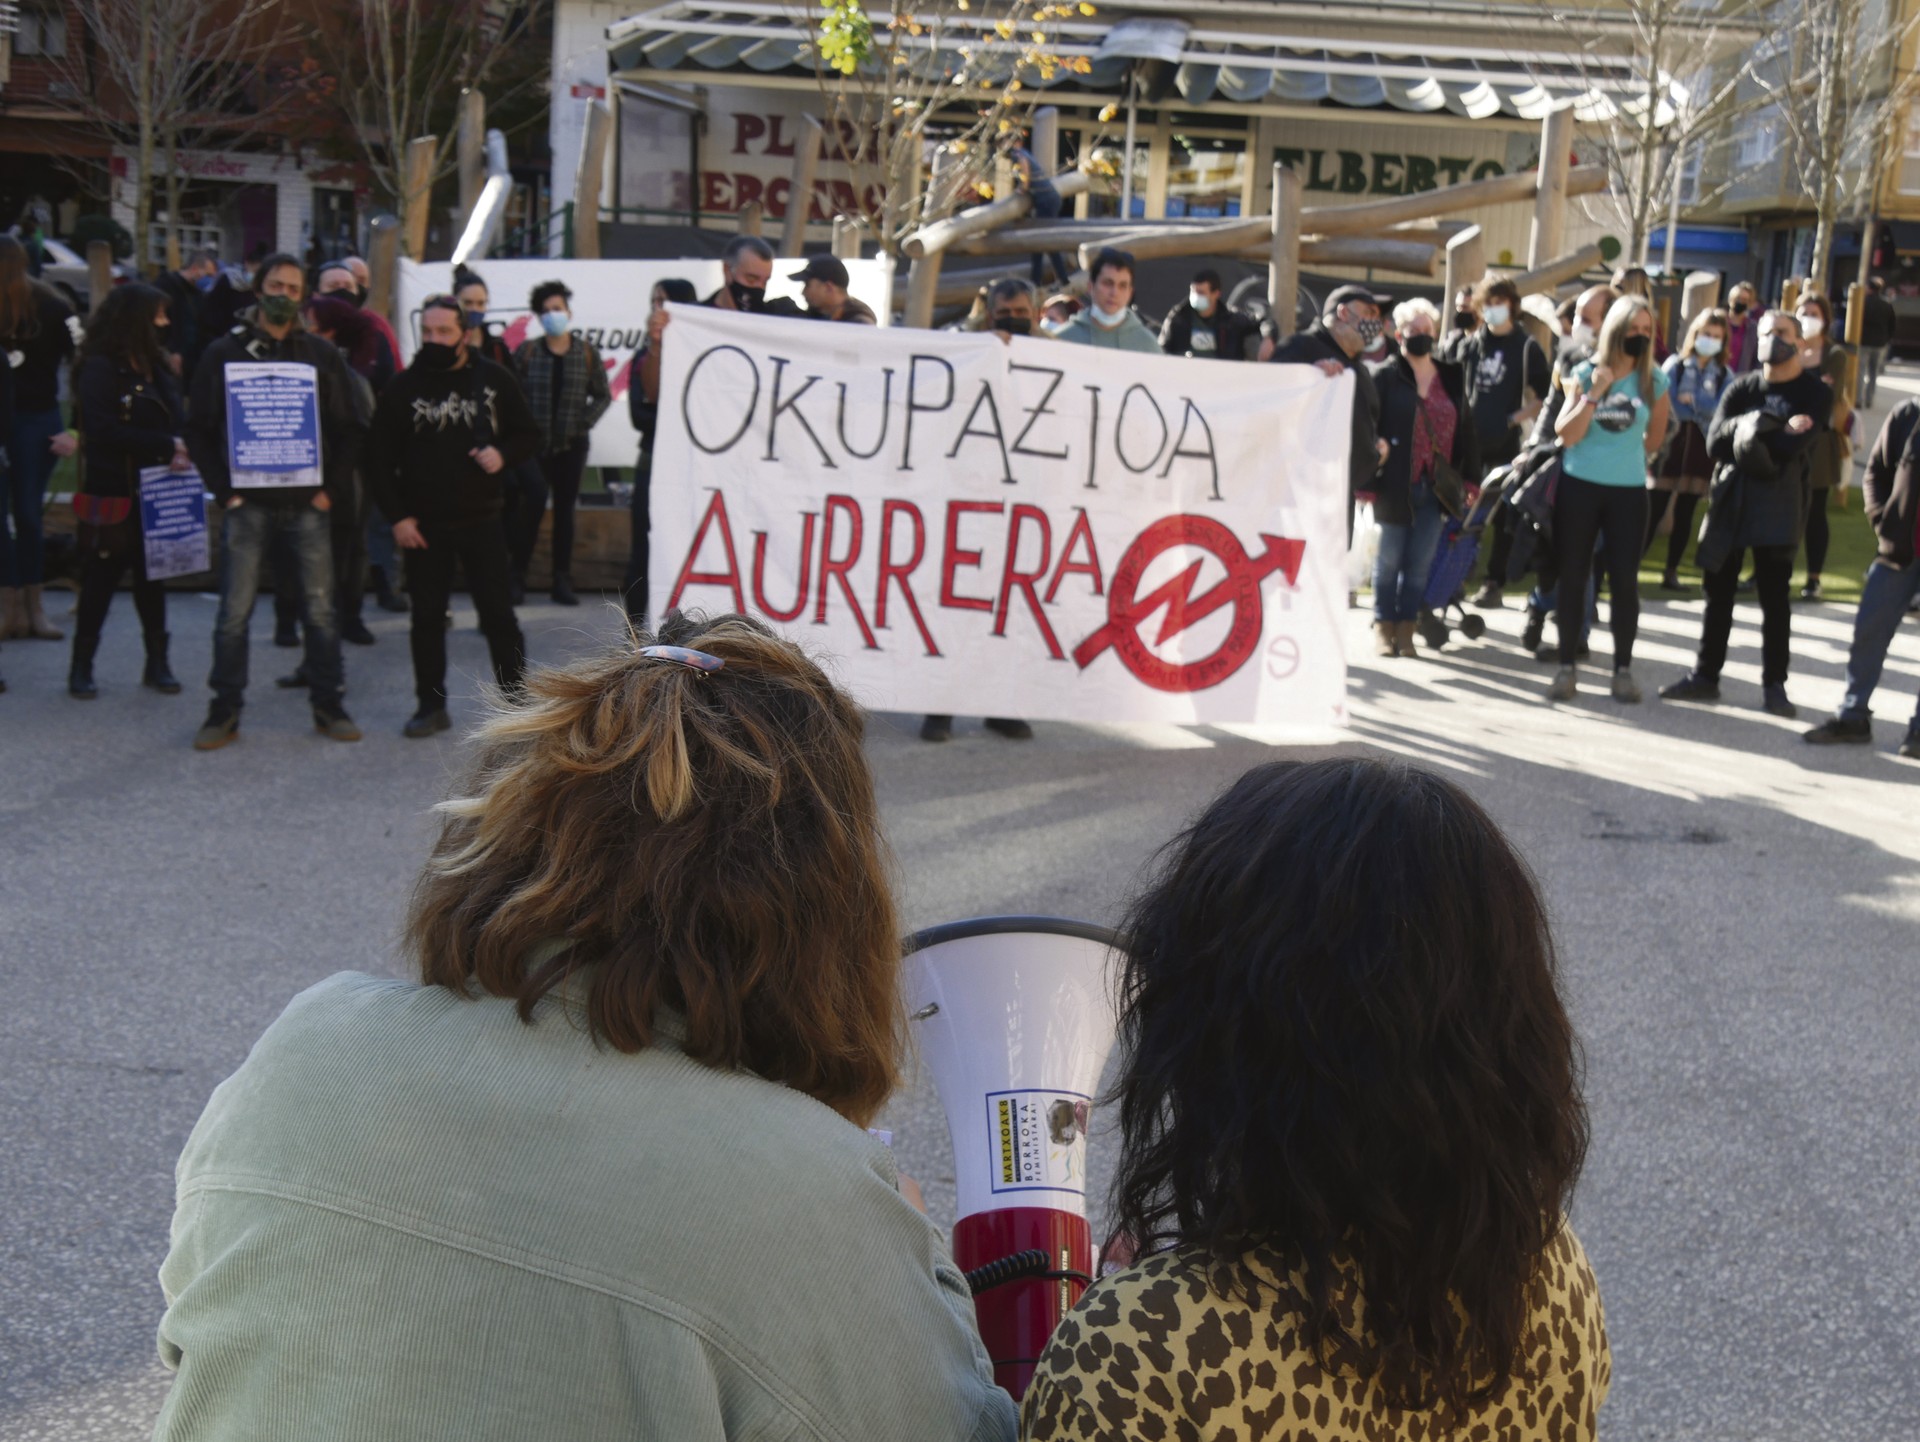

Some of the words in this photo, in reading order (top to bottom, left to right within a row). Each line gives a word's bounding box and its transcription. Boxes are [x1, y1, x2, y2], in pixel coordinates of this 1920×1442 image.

[682, 343, 1225, 501] OKUPAZIOA
[661, 486, 1104, 661] AURRERA
[1020, 1104, 1033, 1182] BORROKA
